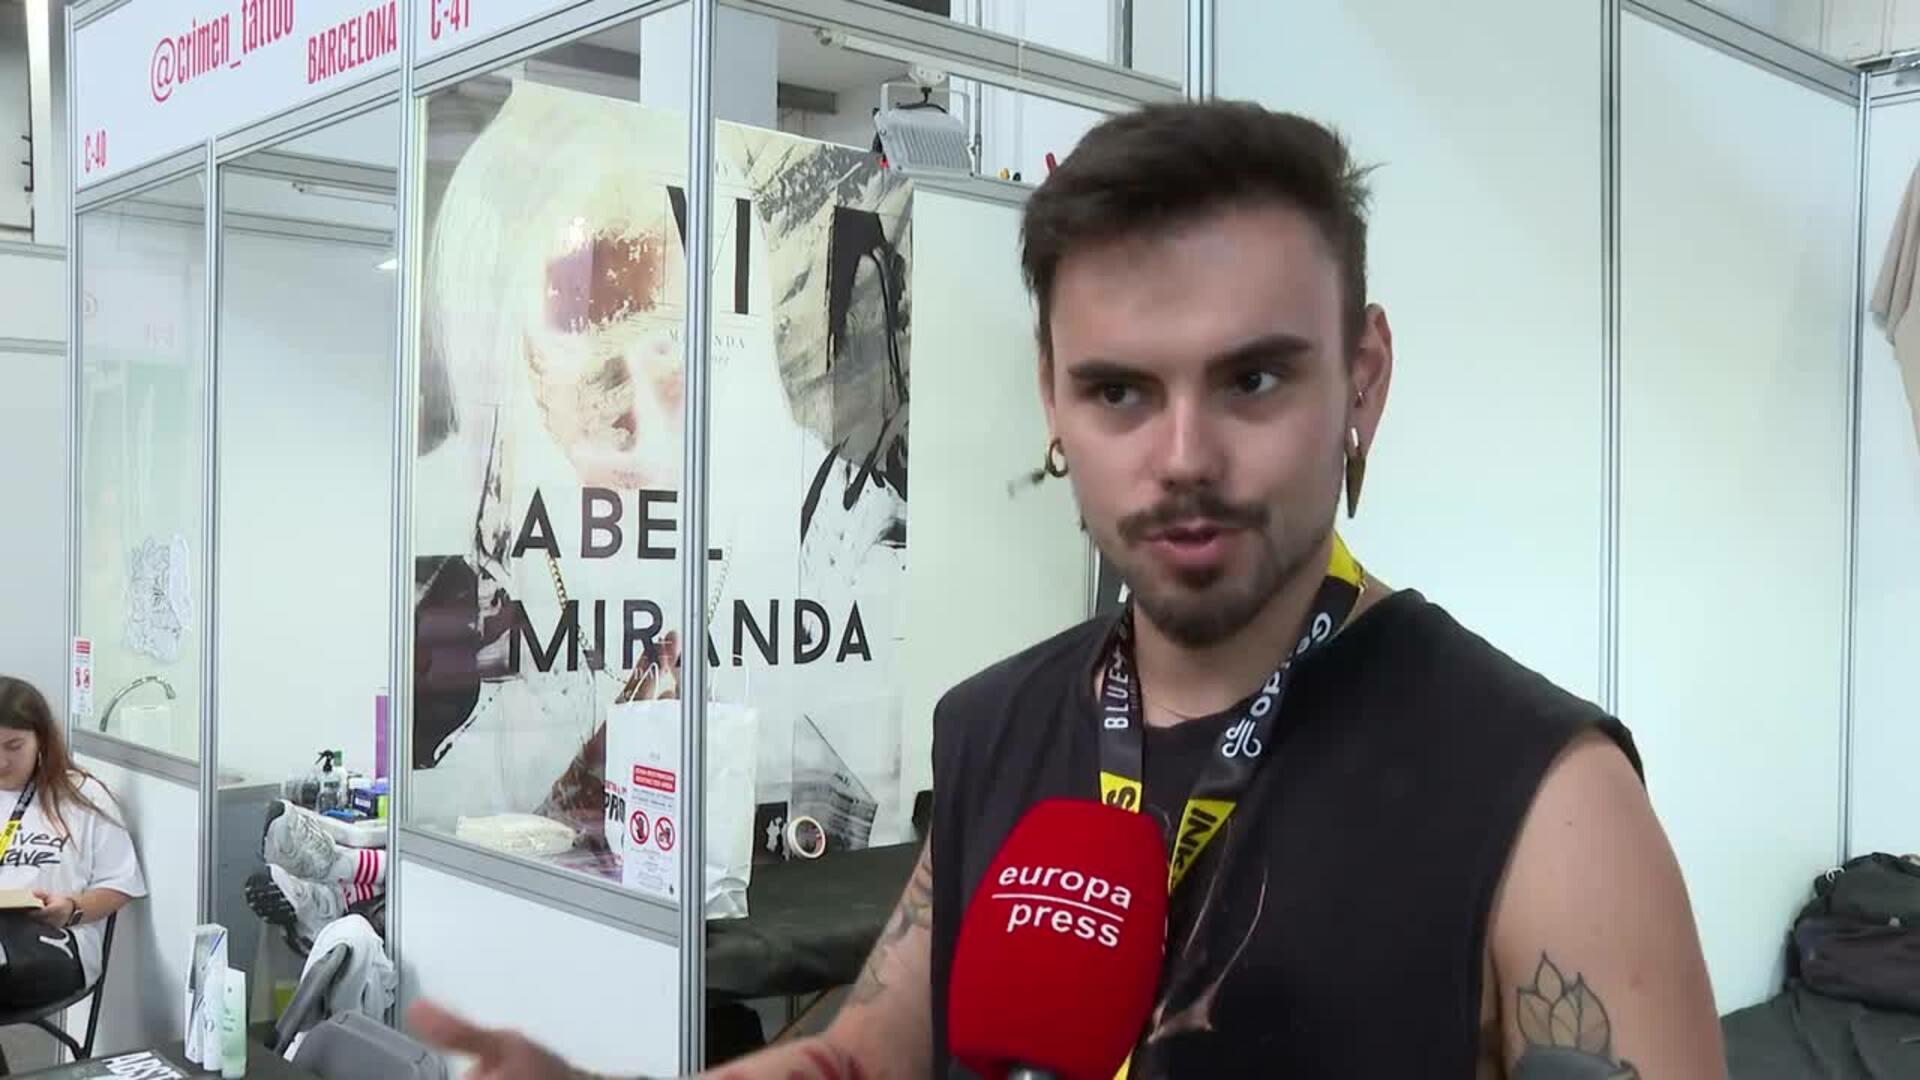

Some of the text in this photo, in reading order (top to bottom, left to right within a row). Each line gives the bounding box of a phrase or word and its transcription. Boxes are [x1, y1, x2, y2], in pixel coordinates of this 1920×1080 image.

[308, 1, 397, 84] BARCELONA
[431, 0, 470, 41] C-41
[511, 486, 722, 560] ABE
[999, 866, 1132, 909] europa
[1007, 903, 1120, 947] press
